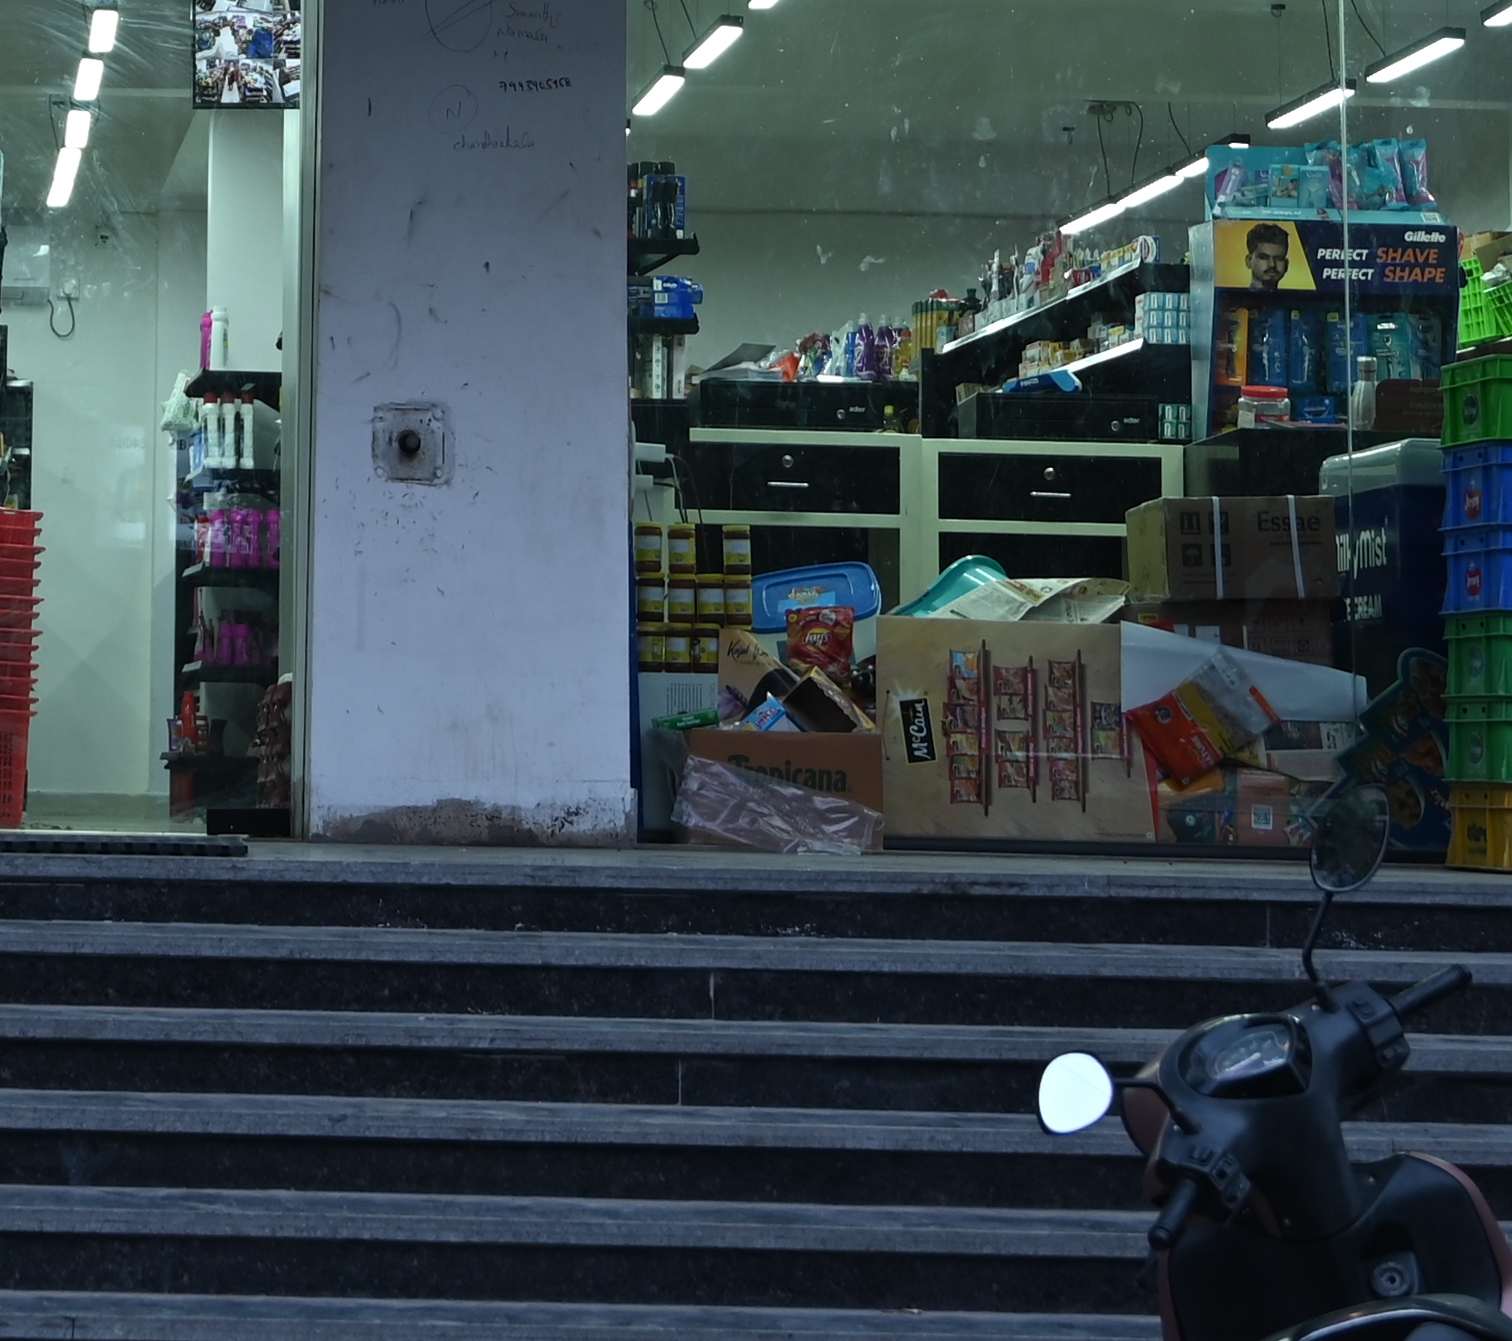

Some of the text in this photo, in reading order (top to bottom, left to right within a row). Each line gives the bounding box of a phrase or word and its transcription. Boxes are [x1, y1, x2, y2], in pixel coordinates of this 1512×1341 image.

[1403, 230, 1447, 244] Gillette
[1376, 247, 1440, 264] SHAVE
[1383, 266, 1447, 284] SHAPE
[907, 698, 933, 762] McCain
